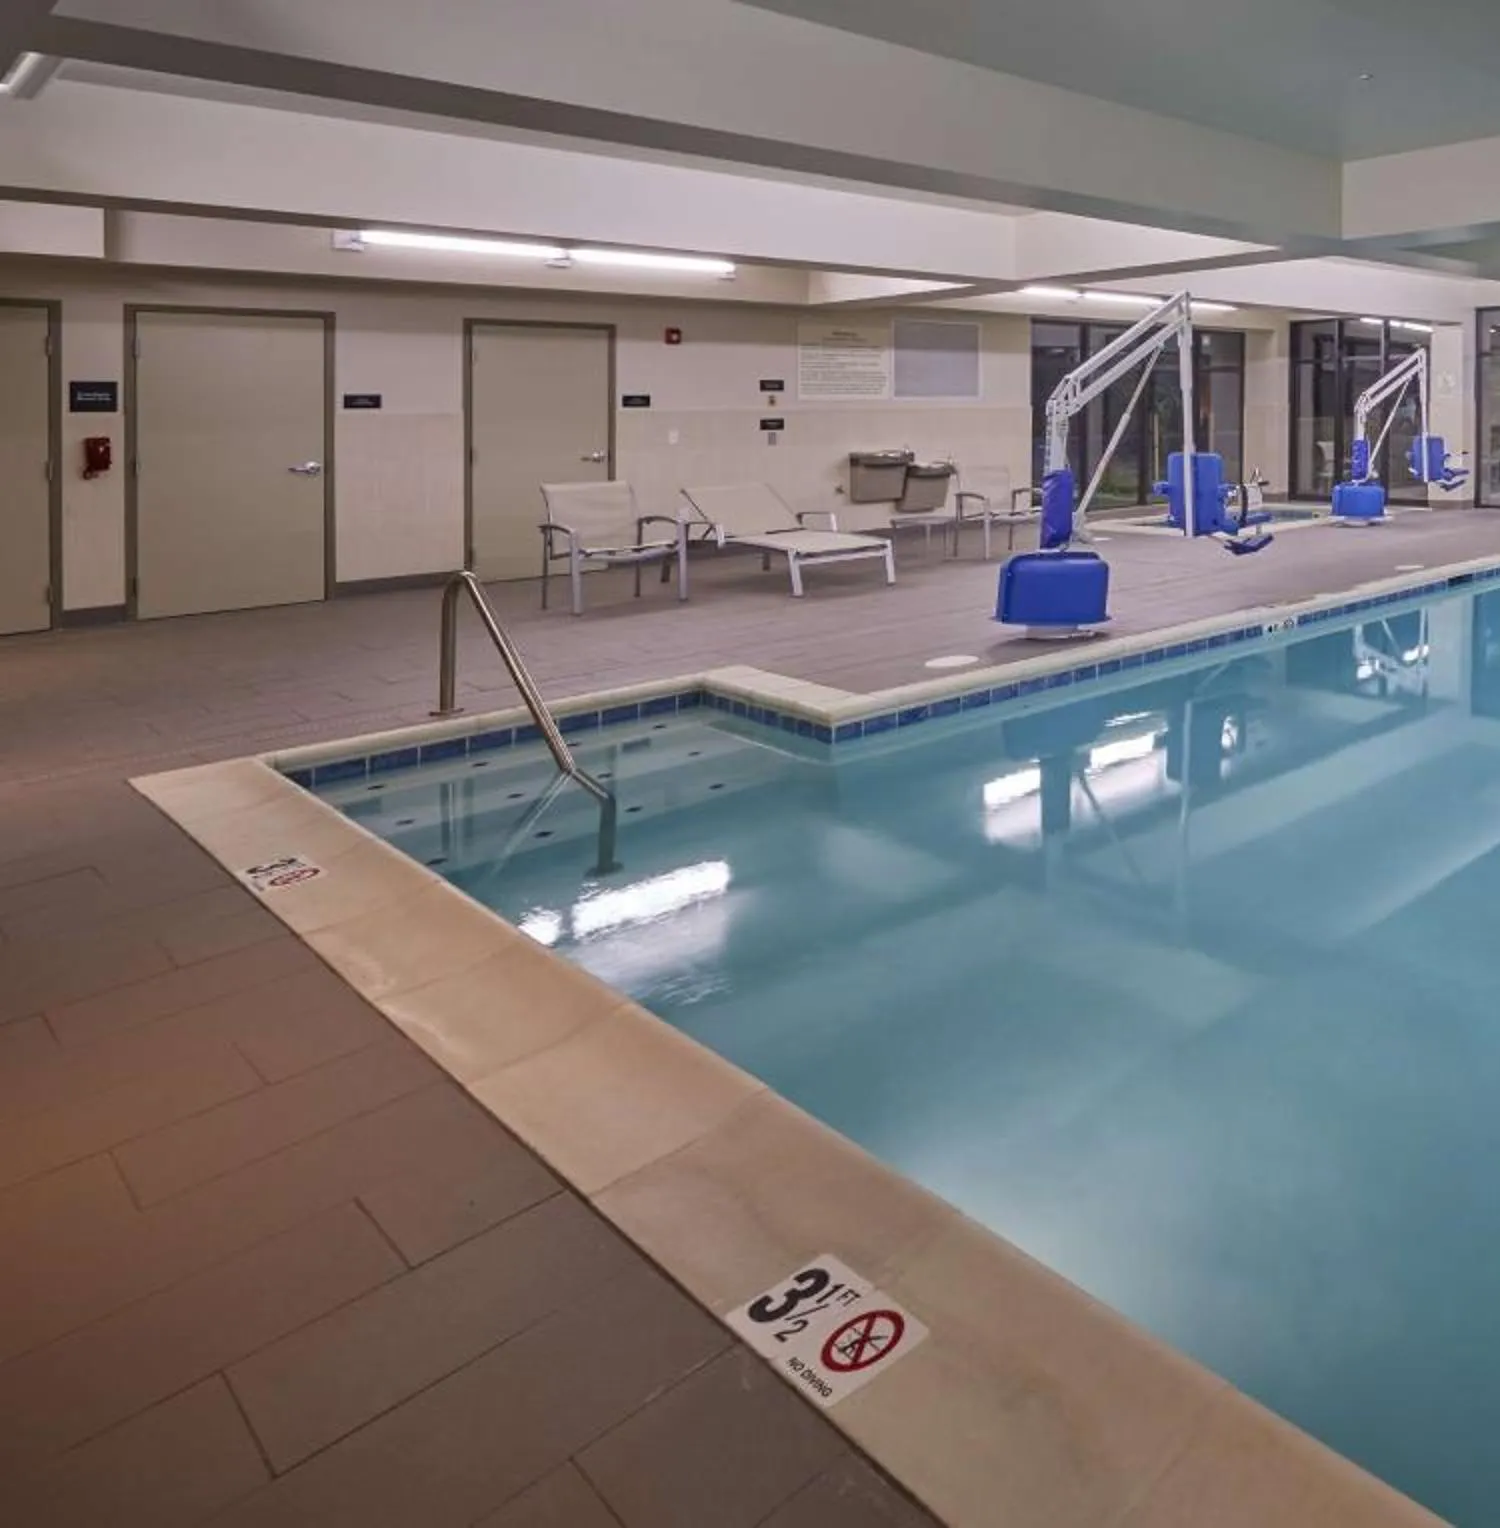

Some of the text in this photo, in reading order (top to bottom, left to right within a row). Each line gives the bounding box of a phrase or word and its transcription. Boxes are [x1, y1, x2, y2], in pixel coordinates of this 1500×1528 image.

[747, 1268, 831, 1323] 3
[788, 1356, 833, 1397] NO DIVING
